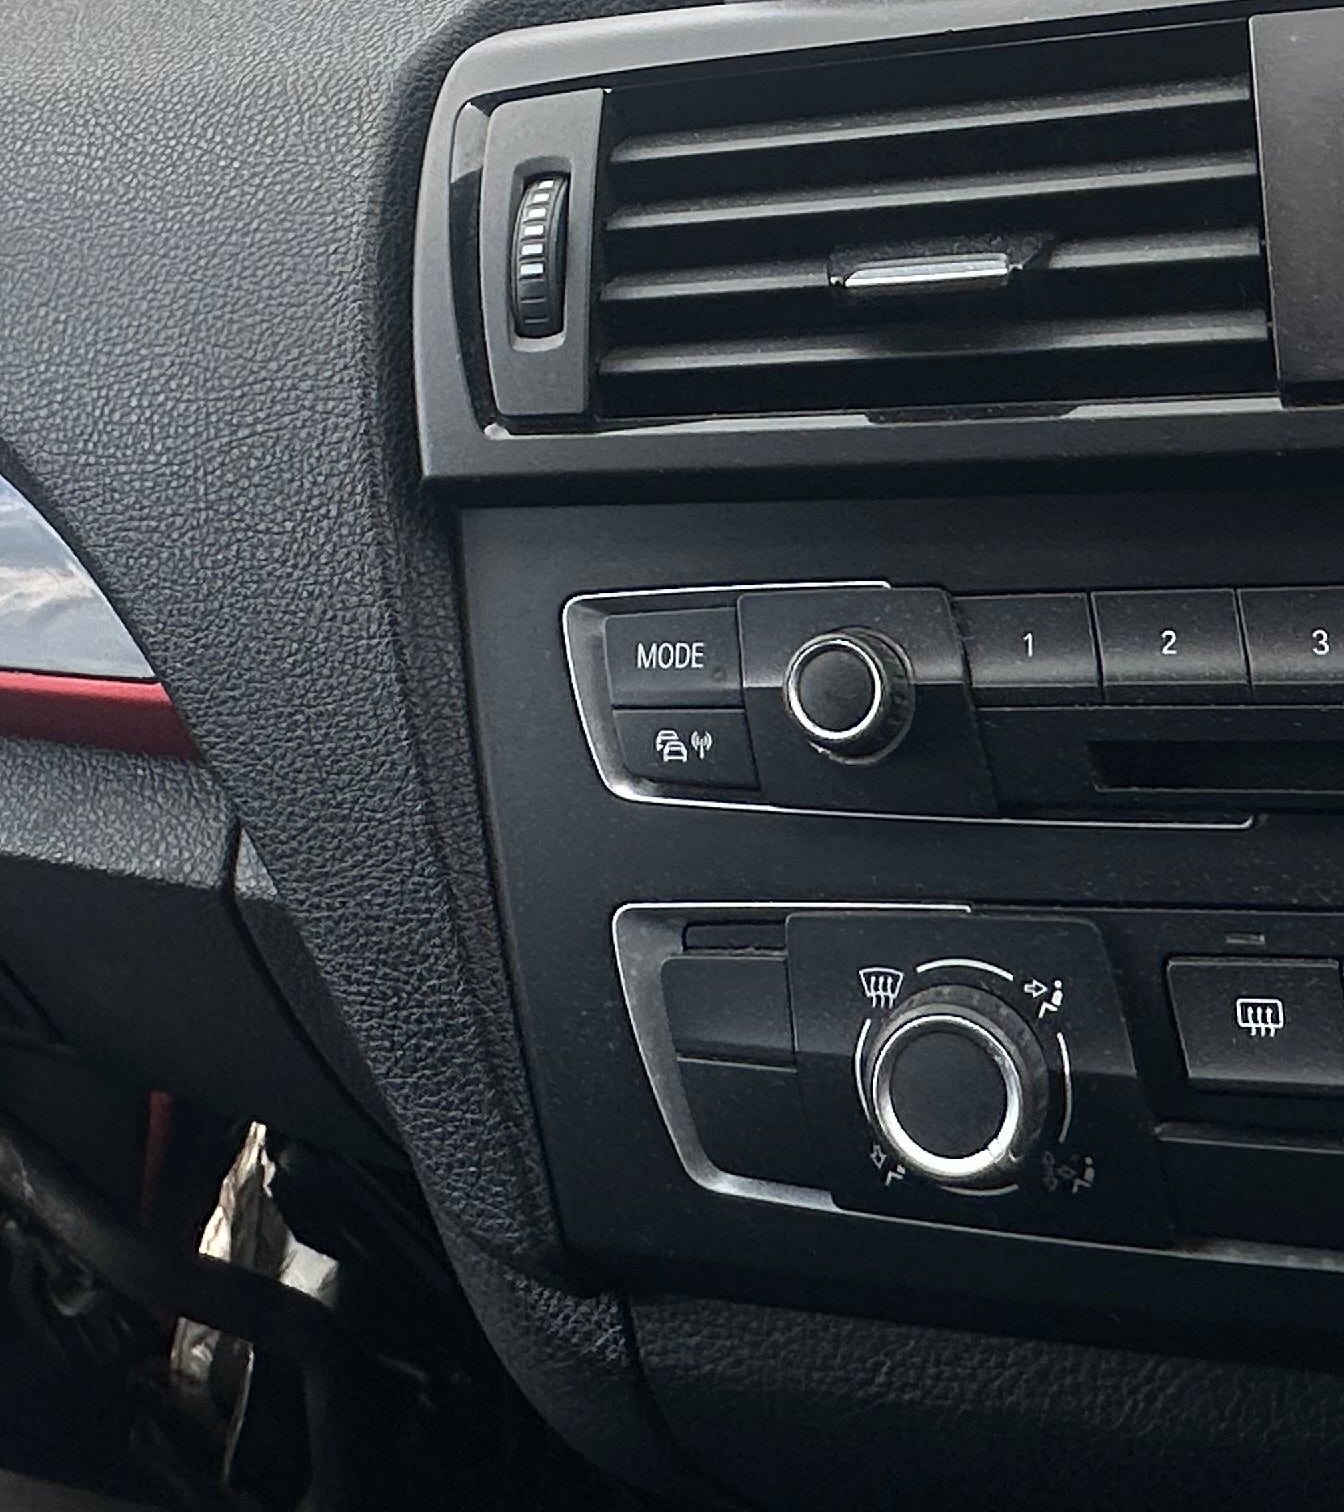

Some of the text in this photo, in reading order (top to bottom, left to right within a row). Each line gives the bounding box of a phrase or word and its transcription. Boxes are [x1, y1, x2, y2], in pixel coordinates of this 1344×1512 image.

[1023, 632, 1033, 657] 1
[1161, 630, 1178, 655] 2
[1312, 629, 1330, 656] 3
[637, 642, 705, 670] MODE
